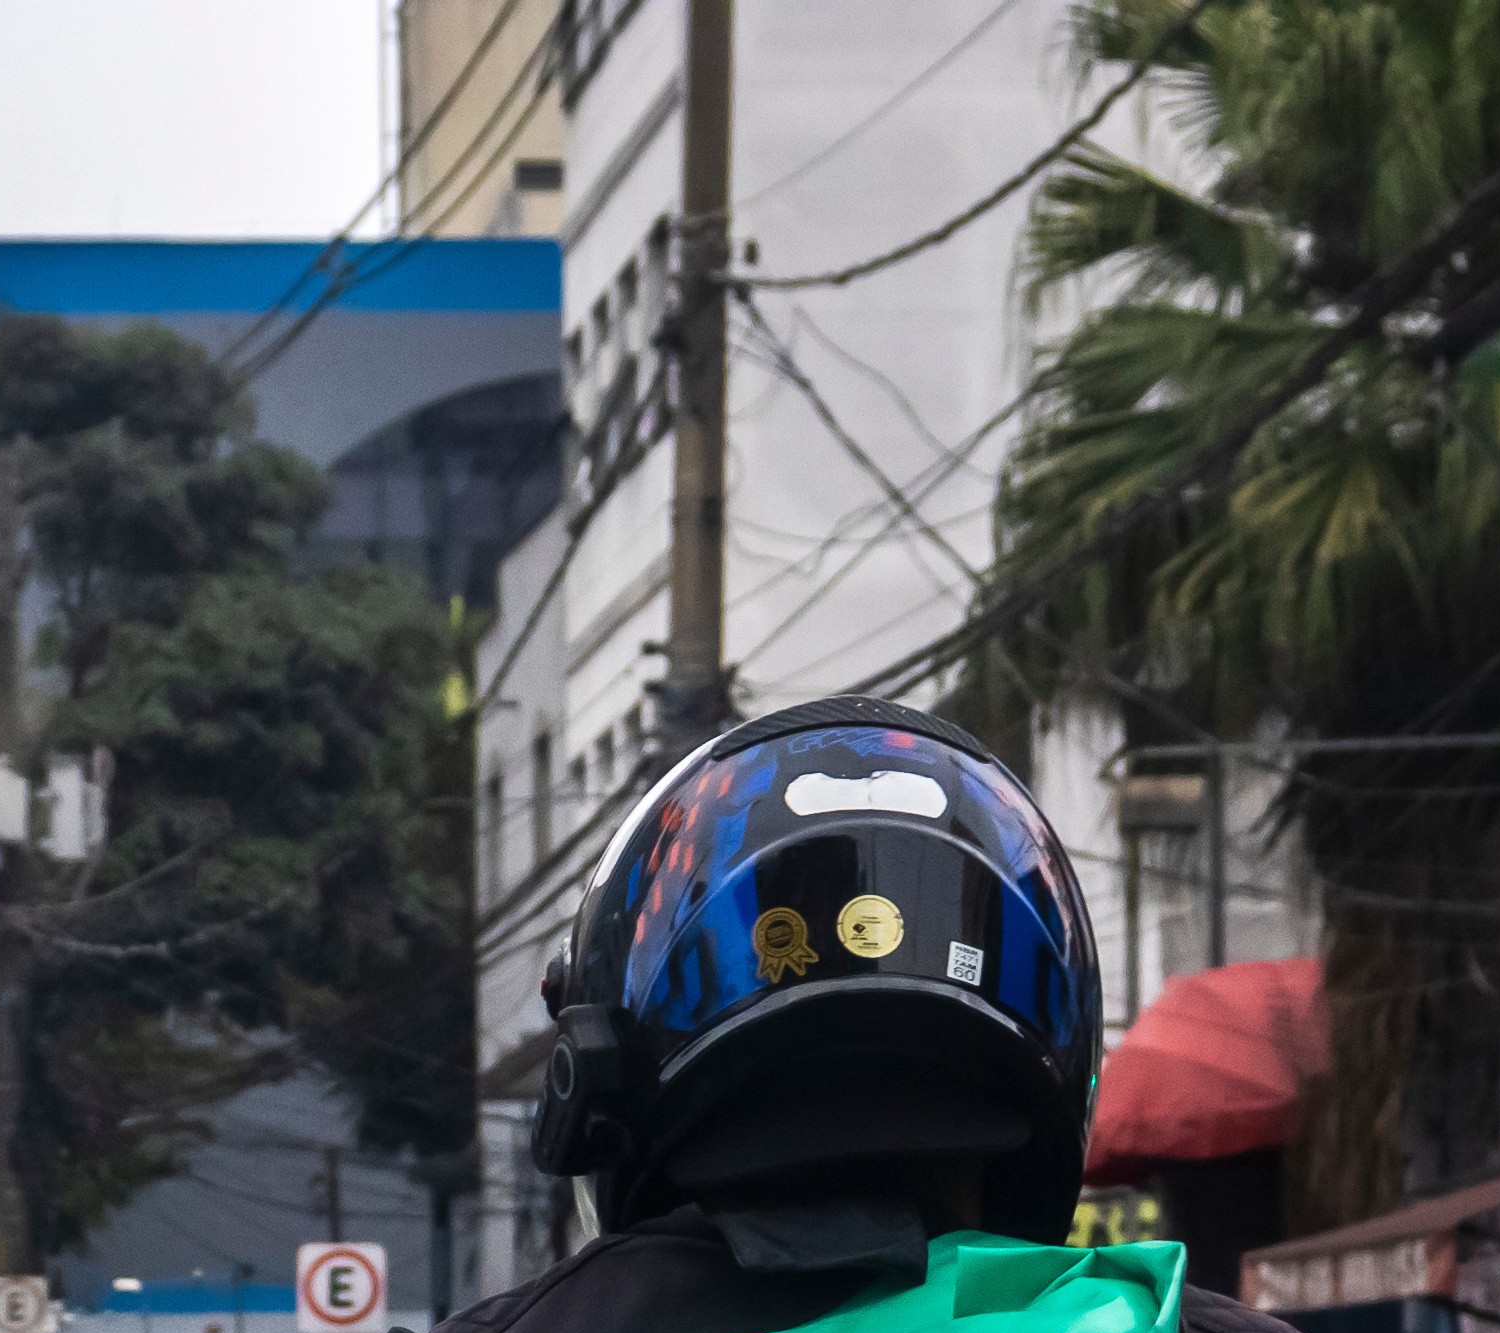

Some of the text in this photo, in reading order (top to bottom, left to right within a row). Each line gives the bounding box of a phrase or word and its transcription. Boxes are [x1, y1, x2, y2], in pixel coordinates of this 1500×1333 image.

[953, 966, 976, 981] 60
[328, 1266, 355, 1309] E
[5, 1290, 24, 1322] E
